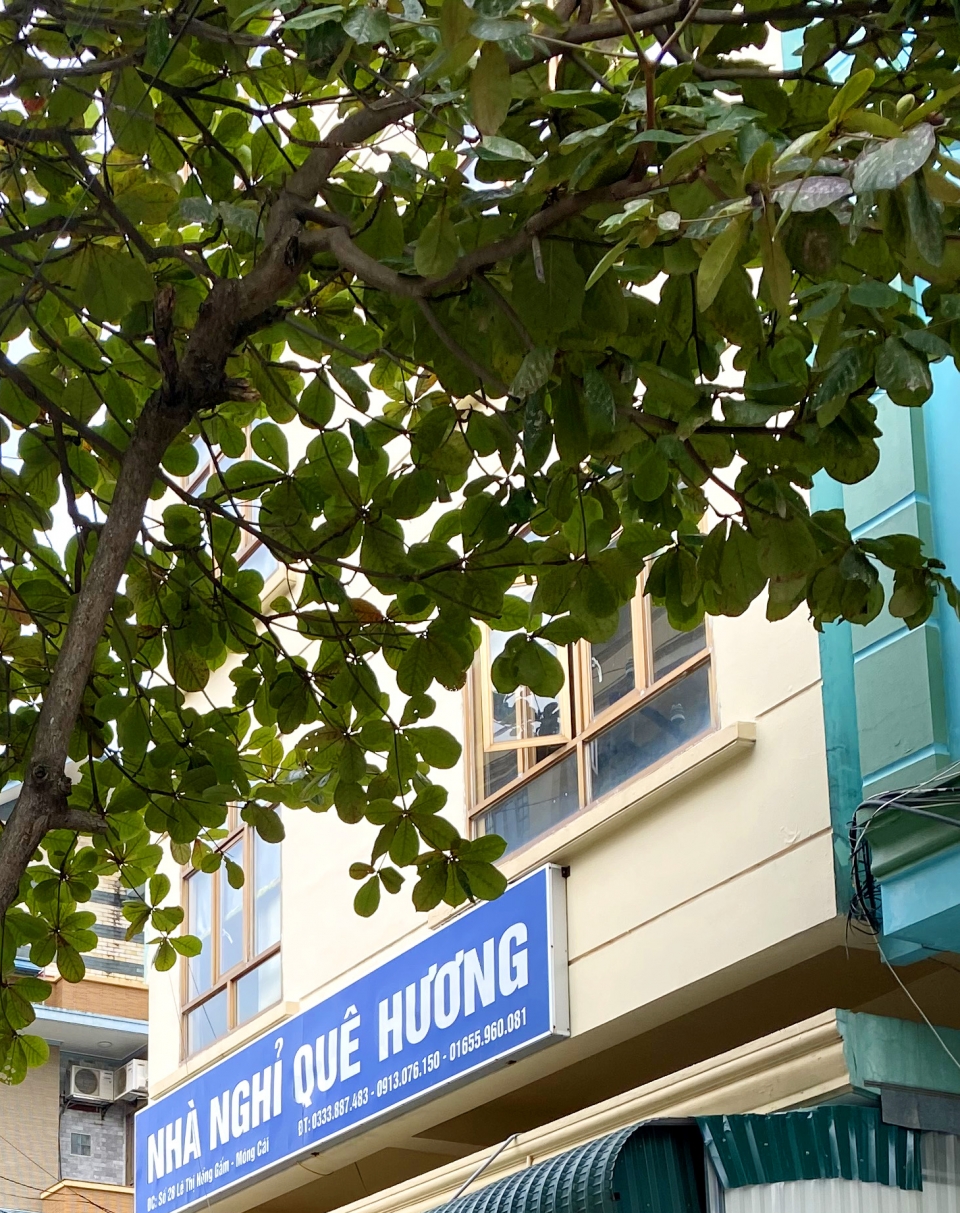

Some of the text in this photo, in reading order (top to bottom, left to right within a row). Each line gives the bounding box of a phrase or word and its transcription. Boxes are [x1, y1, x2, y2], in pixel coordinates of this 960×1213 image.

[147, 922, 529, 1184] NHÀ NGHỈ QUÊ HƯƠNG
[377, 1050, 440, 1098] 0913.076.150
[449, 1006, 527, 1062] 01655.960.081
[176, 1181, 185, 1198] Lê
[185, 1174, 196, 1193] Thị
[256, 1136, 270, 1157] Cái
